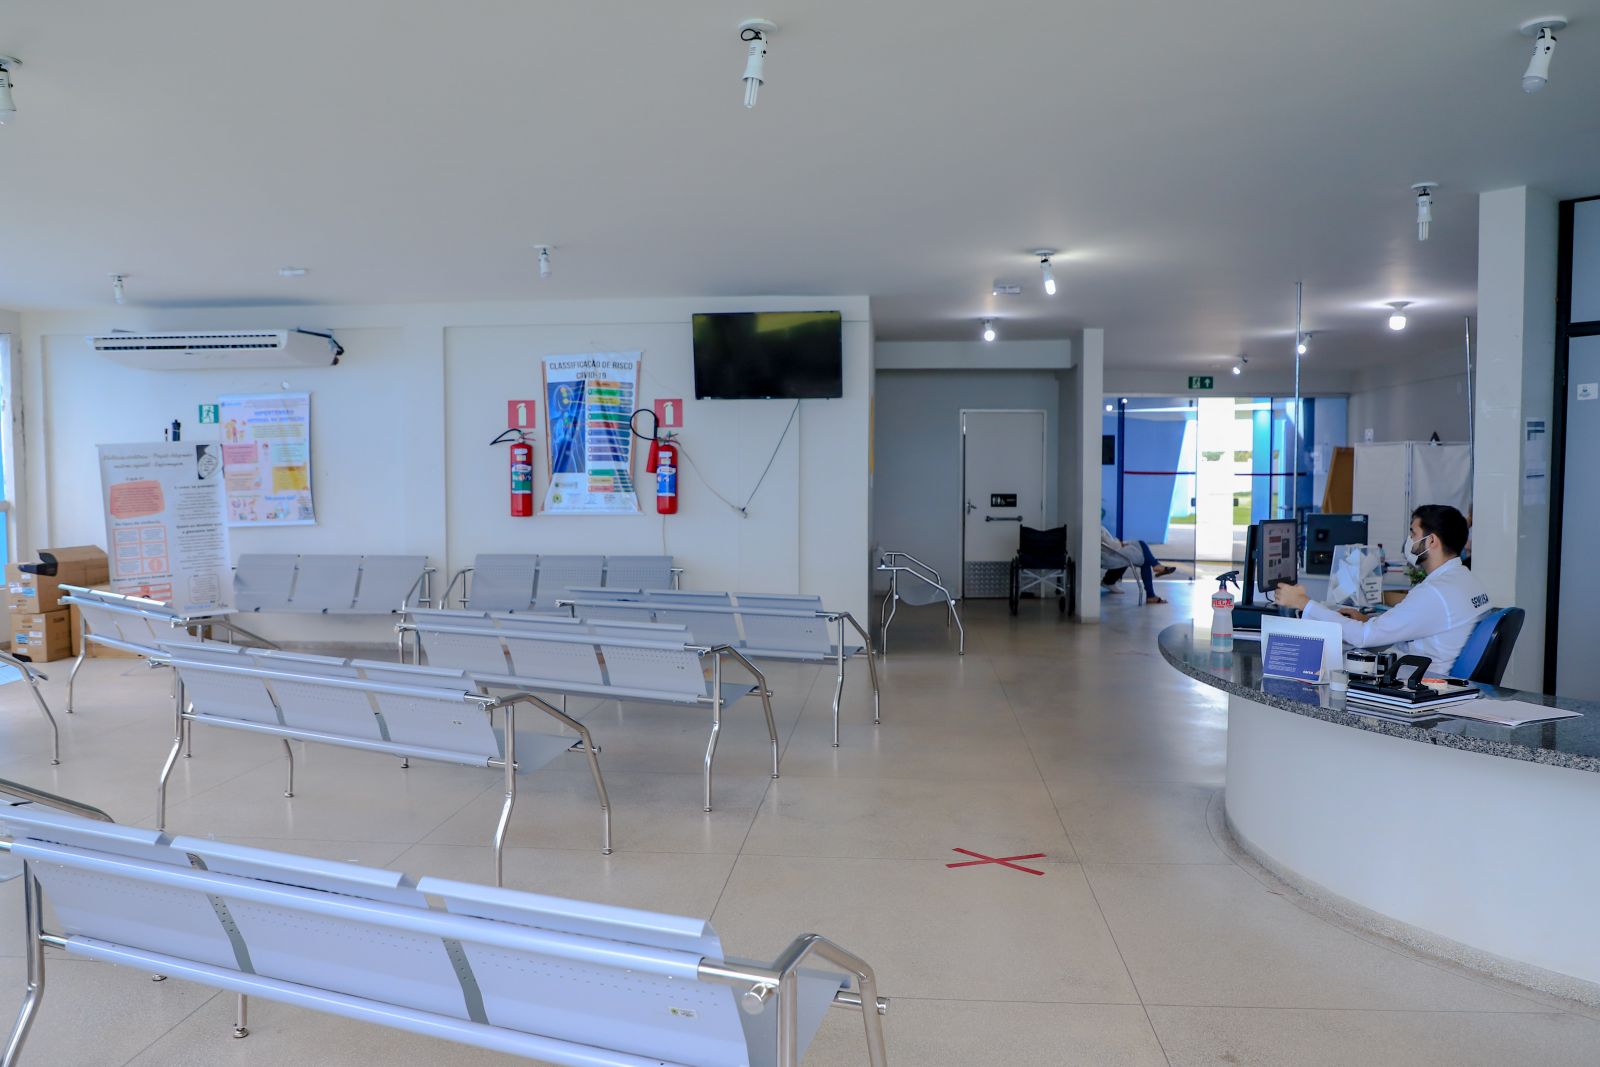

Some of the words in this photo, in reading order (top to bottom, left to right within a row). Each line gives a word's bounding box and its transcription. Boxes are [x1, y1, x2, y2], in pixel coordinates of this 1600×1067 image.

[549, 359, 601, 370] CLASSIFICAÇÃO
[601, 361, 611, 369] DE
[612, 361, 633, 370] RISCO
[575, 371, 607, 379] COVID-19
